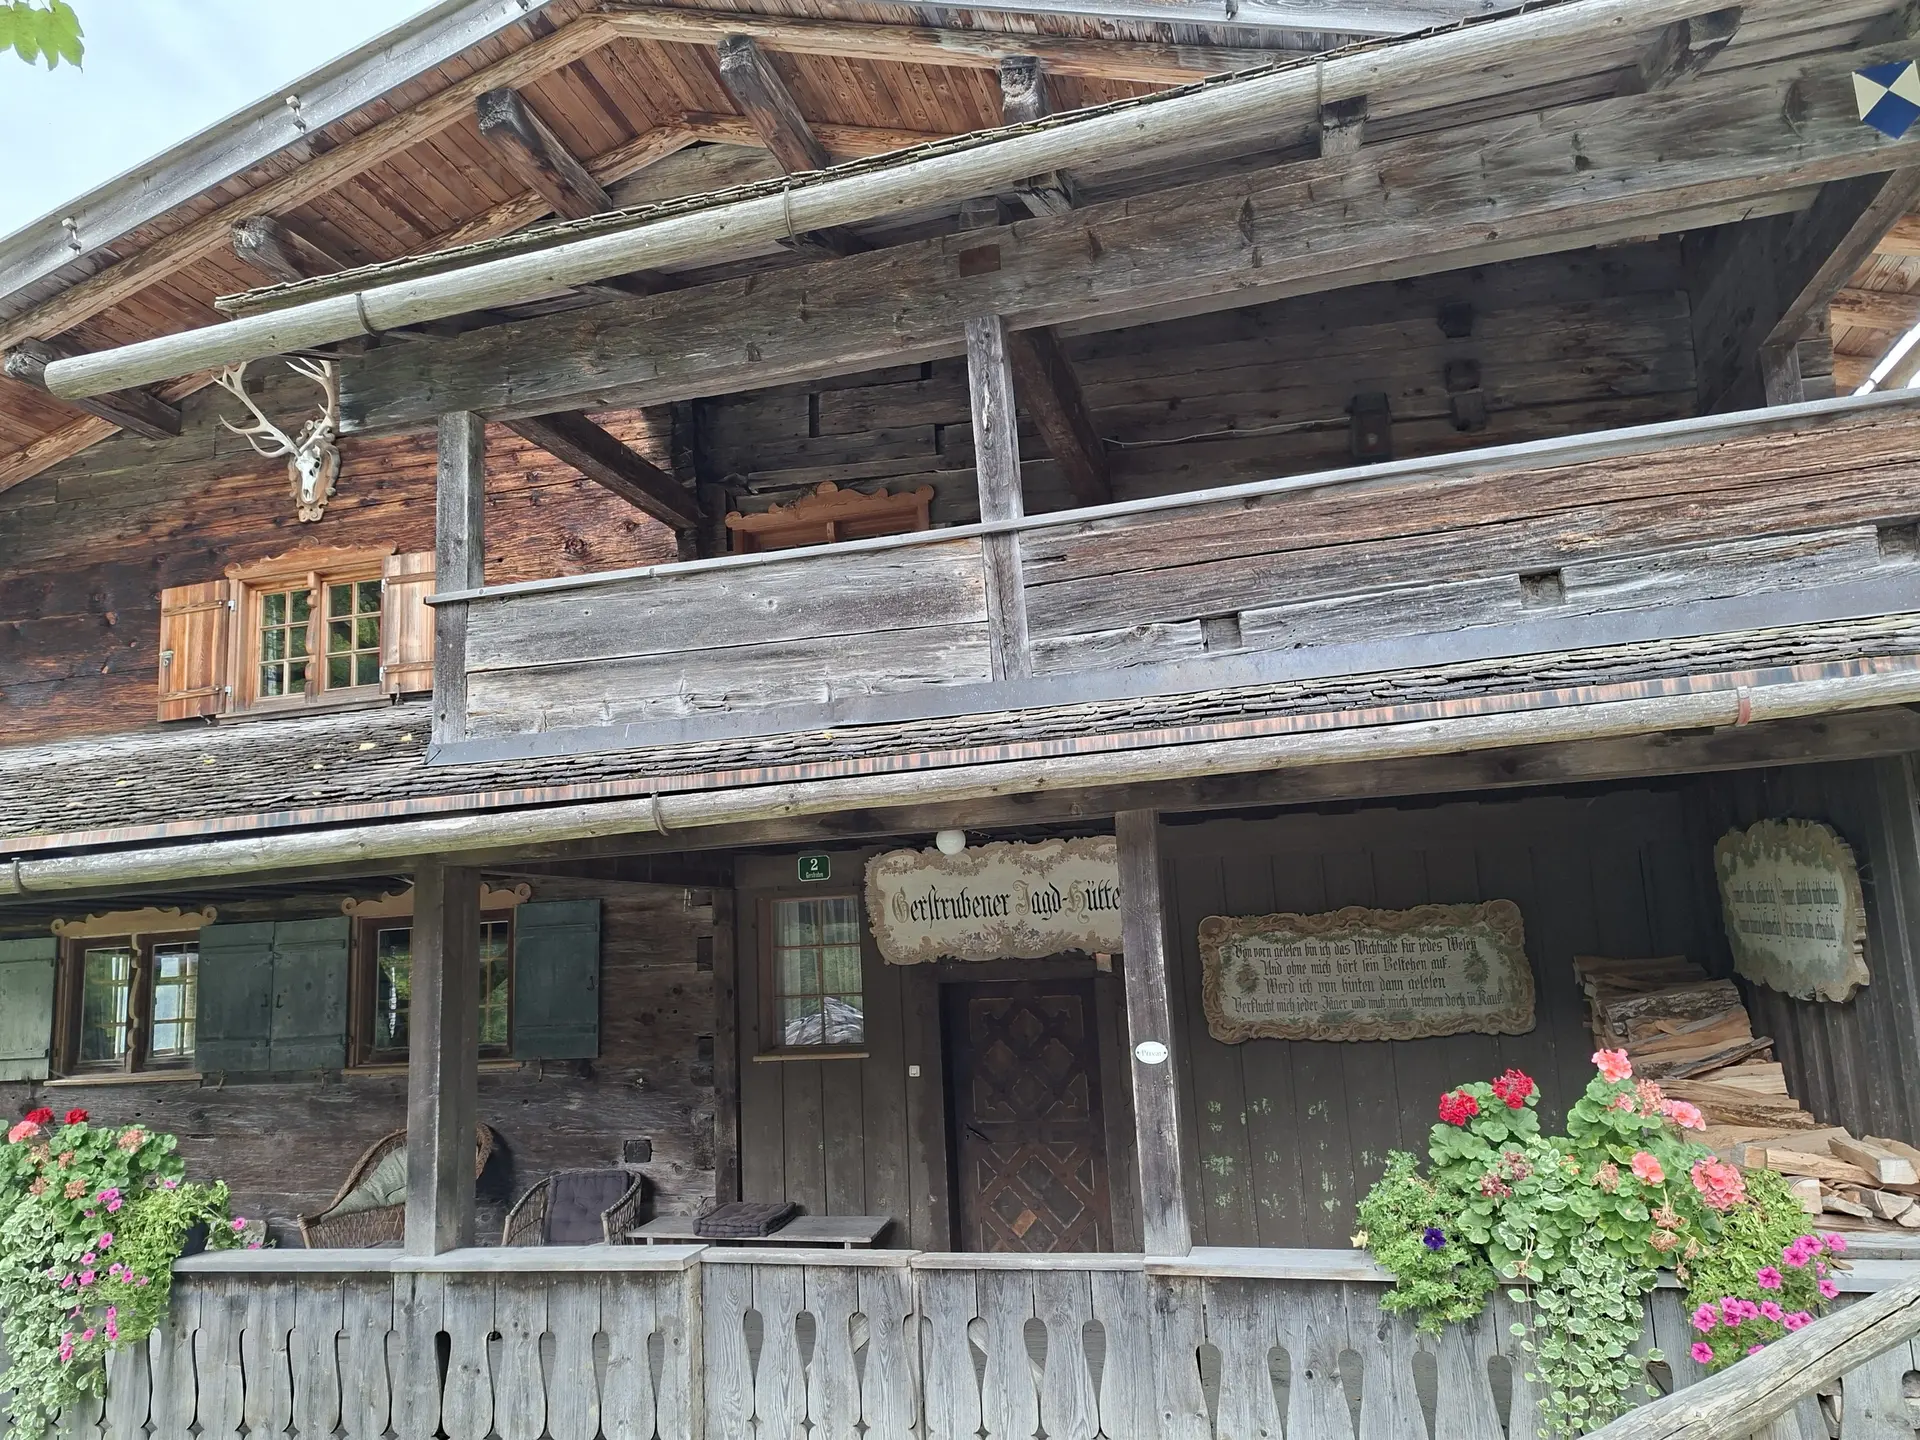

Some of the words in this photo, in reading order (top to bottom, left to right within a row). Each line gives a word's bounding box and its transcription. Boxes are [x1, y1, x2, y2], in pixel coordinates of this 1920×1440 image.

[810, 858, 819, 871] 2
[1232, 943, 1253, 960] Von
[1304, 942, 1318, 958] bin
[1318, 941, 1332, 960] ich
[1334, 941, 1351, 956] das
[1418, 938, 1443, 956] jedes
[1286, 960, 1307, 978] ohne
[1310, 959, 1332, 978] mich
[1298, 978, 1313, 996] ich
[1317, 981, 1337, 993] von
[1379, 975, 1404, 993] dann
[1275, 997, 1296, 1016] mich
[1296, 997, 1318, 1015] jeder
[1351, 995, 1367, 1010] und
[1444, 991, 1466, 1009] doch
[1466, 991, 1477, 1006] in
